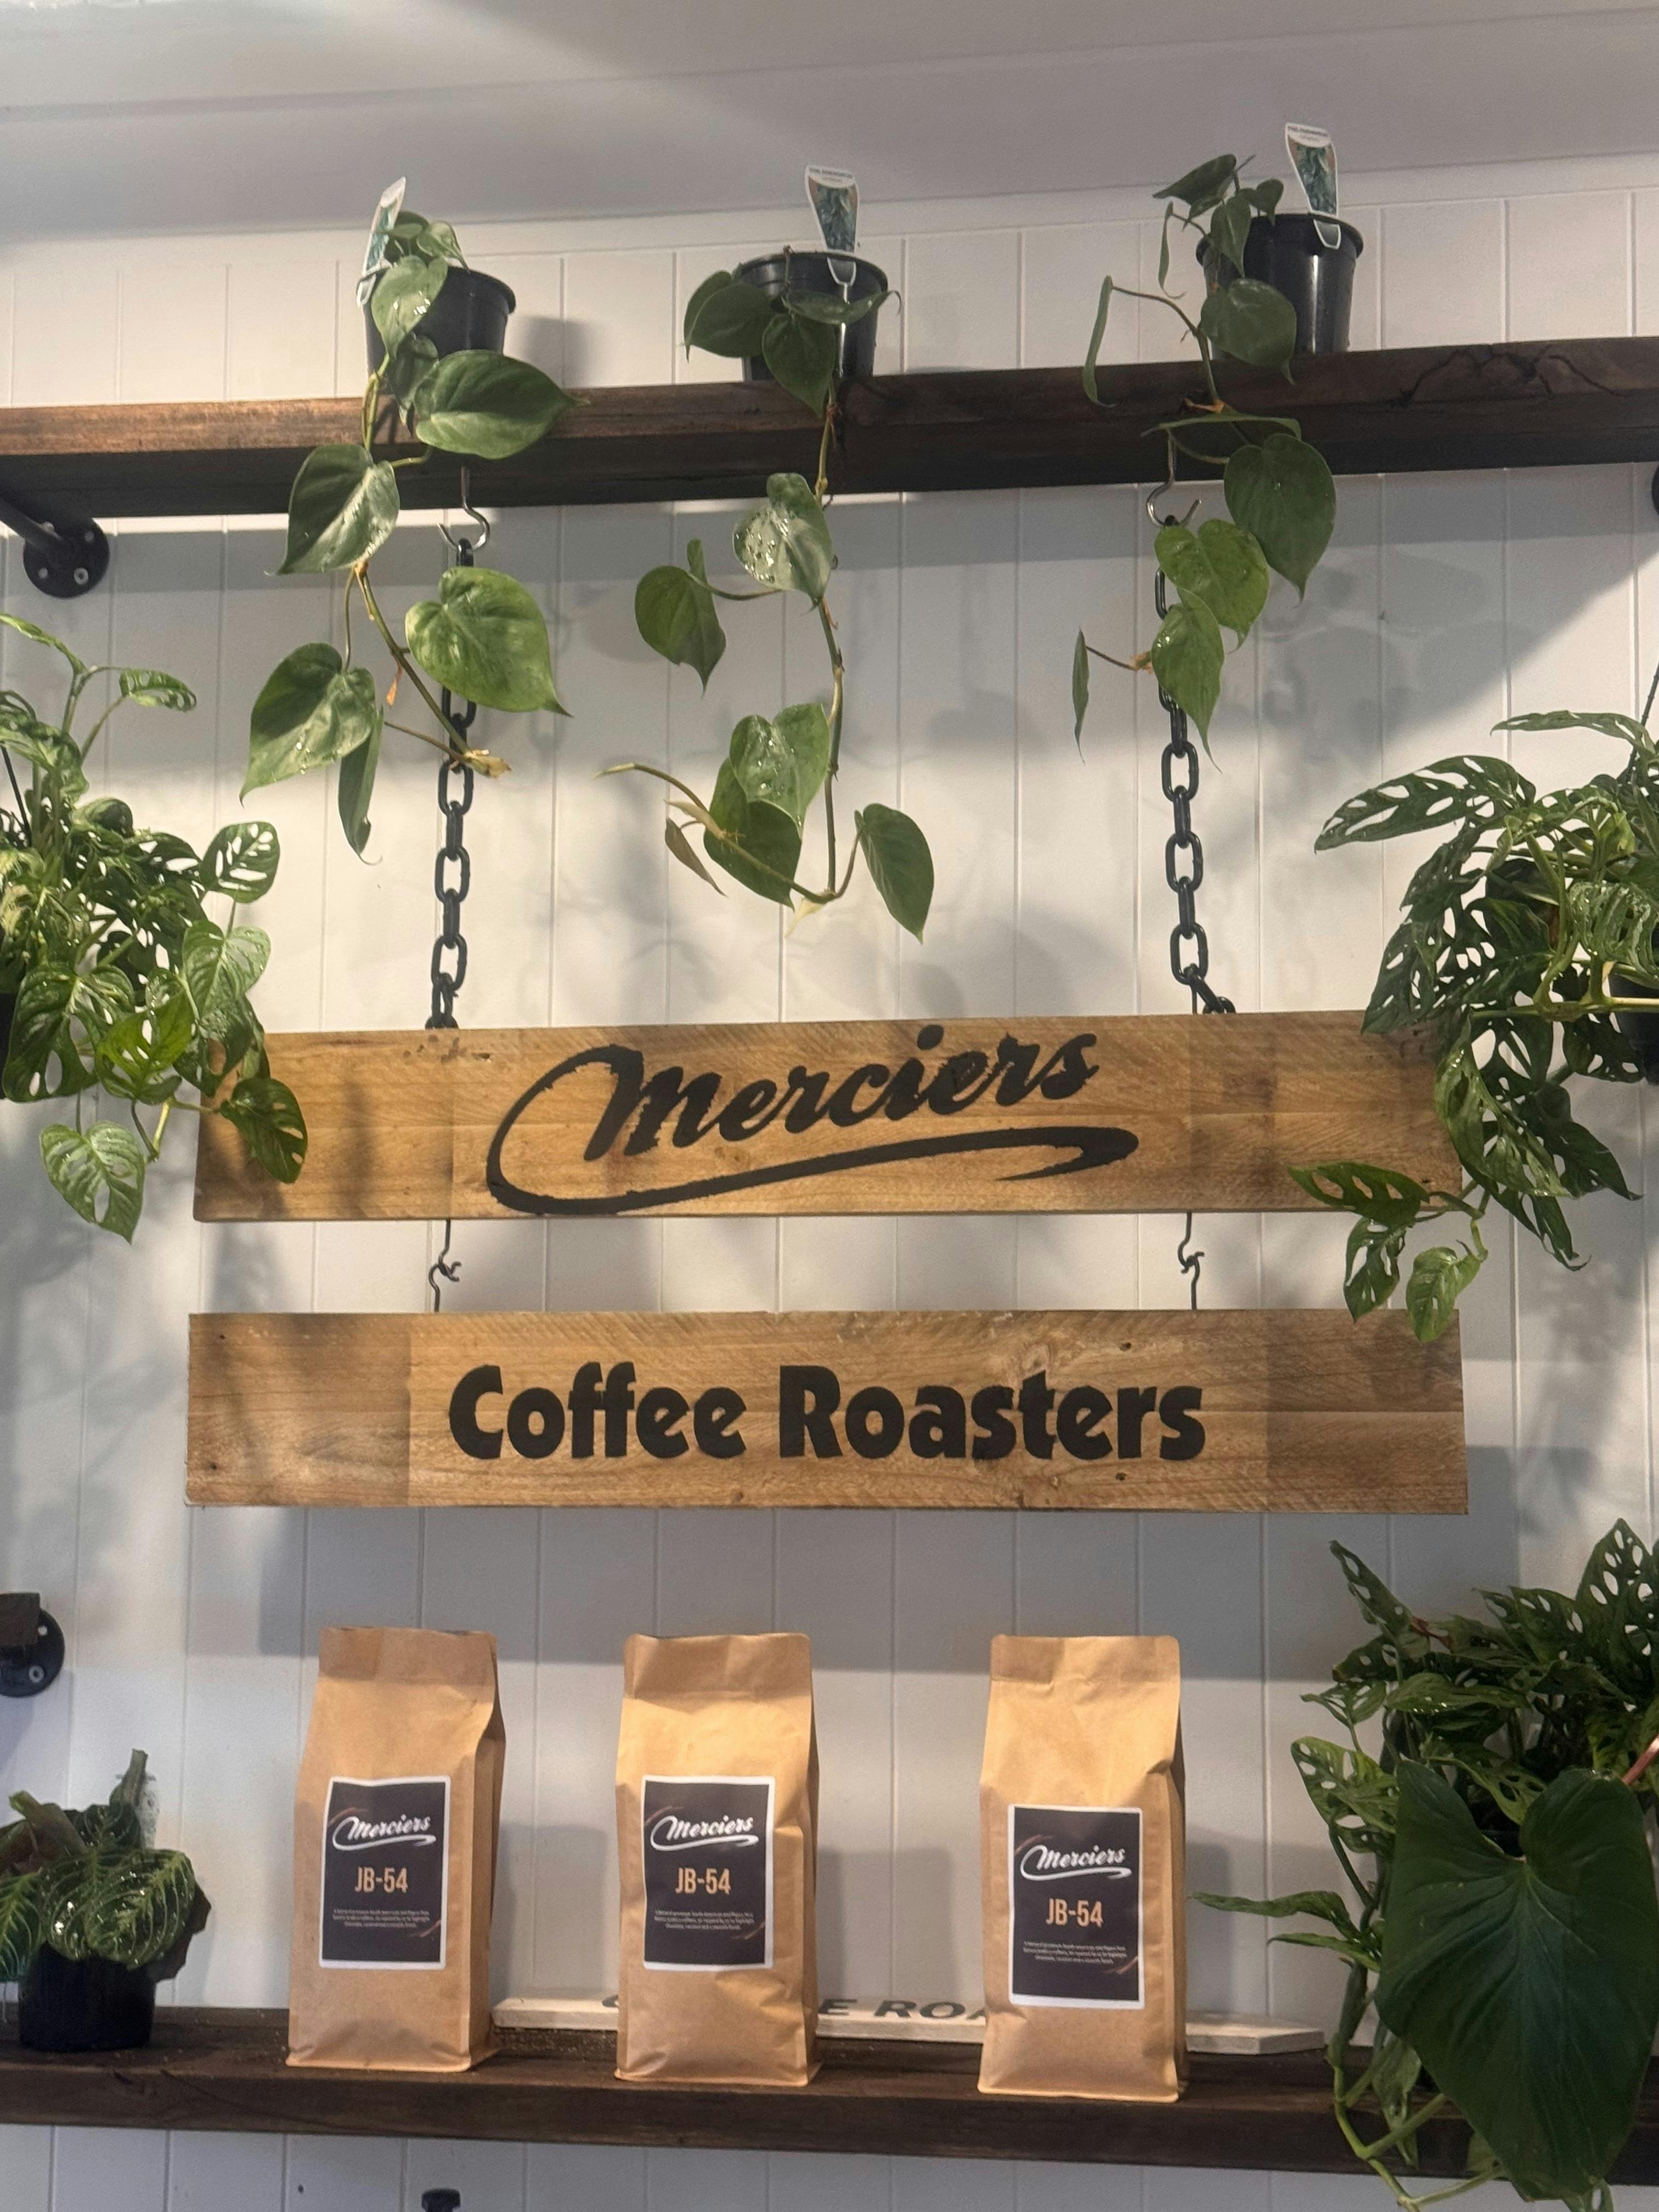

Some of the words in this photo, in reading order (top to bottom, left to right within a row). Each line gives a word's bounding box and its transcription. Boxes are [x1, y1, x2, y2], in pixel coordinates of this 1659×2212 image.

[486, 1024, 1139, 1215] Merciers
[449, 1362, 747, 1460] Coffee
[779, 1365, 1206, 1462] Roasters
[332, 1814, 437, 1851] Merciers
[650, 1815, 759, 1852] Merciers
[354, 1866, 408, 1893] JB-54
[675, 1867, 732, 1895] JB-54
[1020, 1844, 1132, 1881] Merciers
[1046, 1898, 1104, 1928] JB-54
